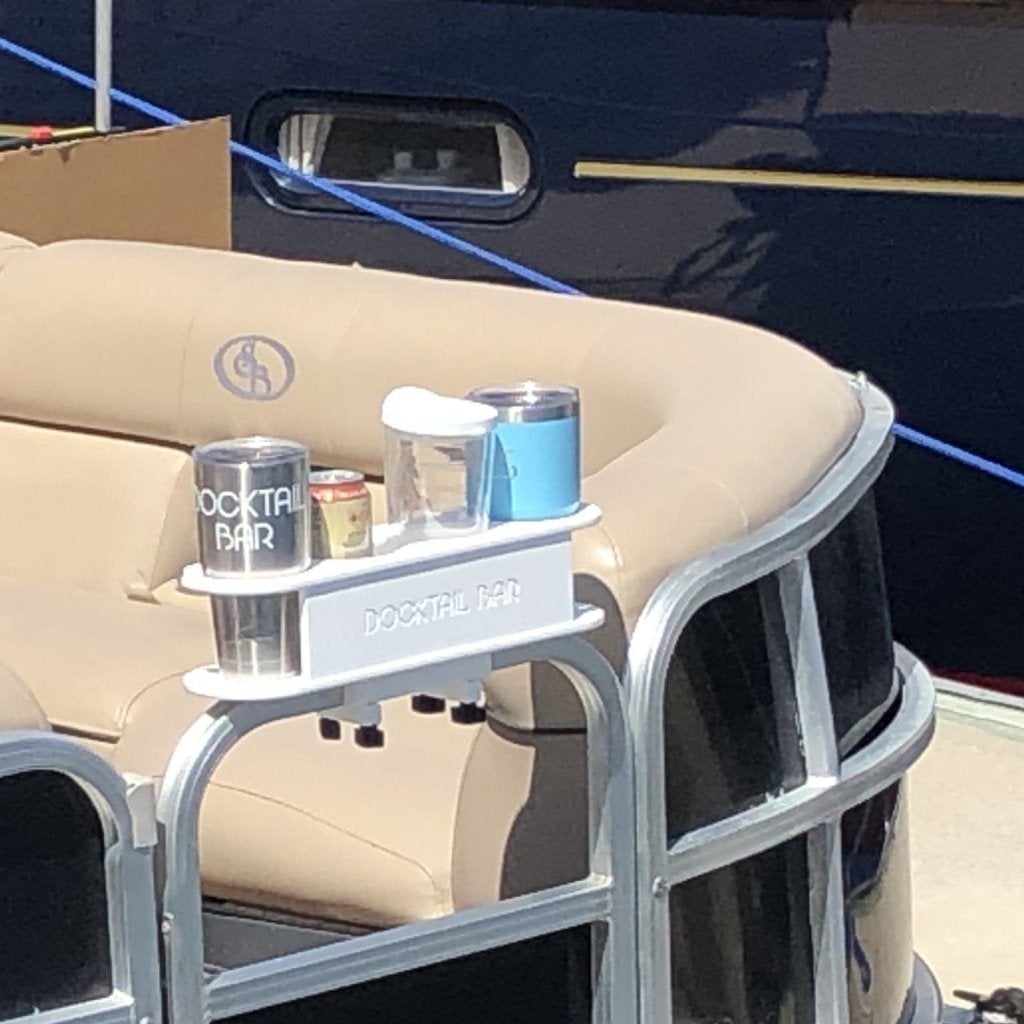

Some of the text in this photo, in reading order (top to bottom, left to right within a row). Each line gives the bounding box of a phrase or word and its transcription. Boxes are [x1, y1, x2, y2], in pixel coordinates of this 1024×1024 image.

[215, 522, 274, 551] BAR
[363, 577, 522, 636] DOCKTAIL BAR
